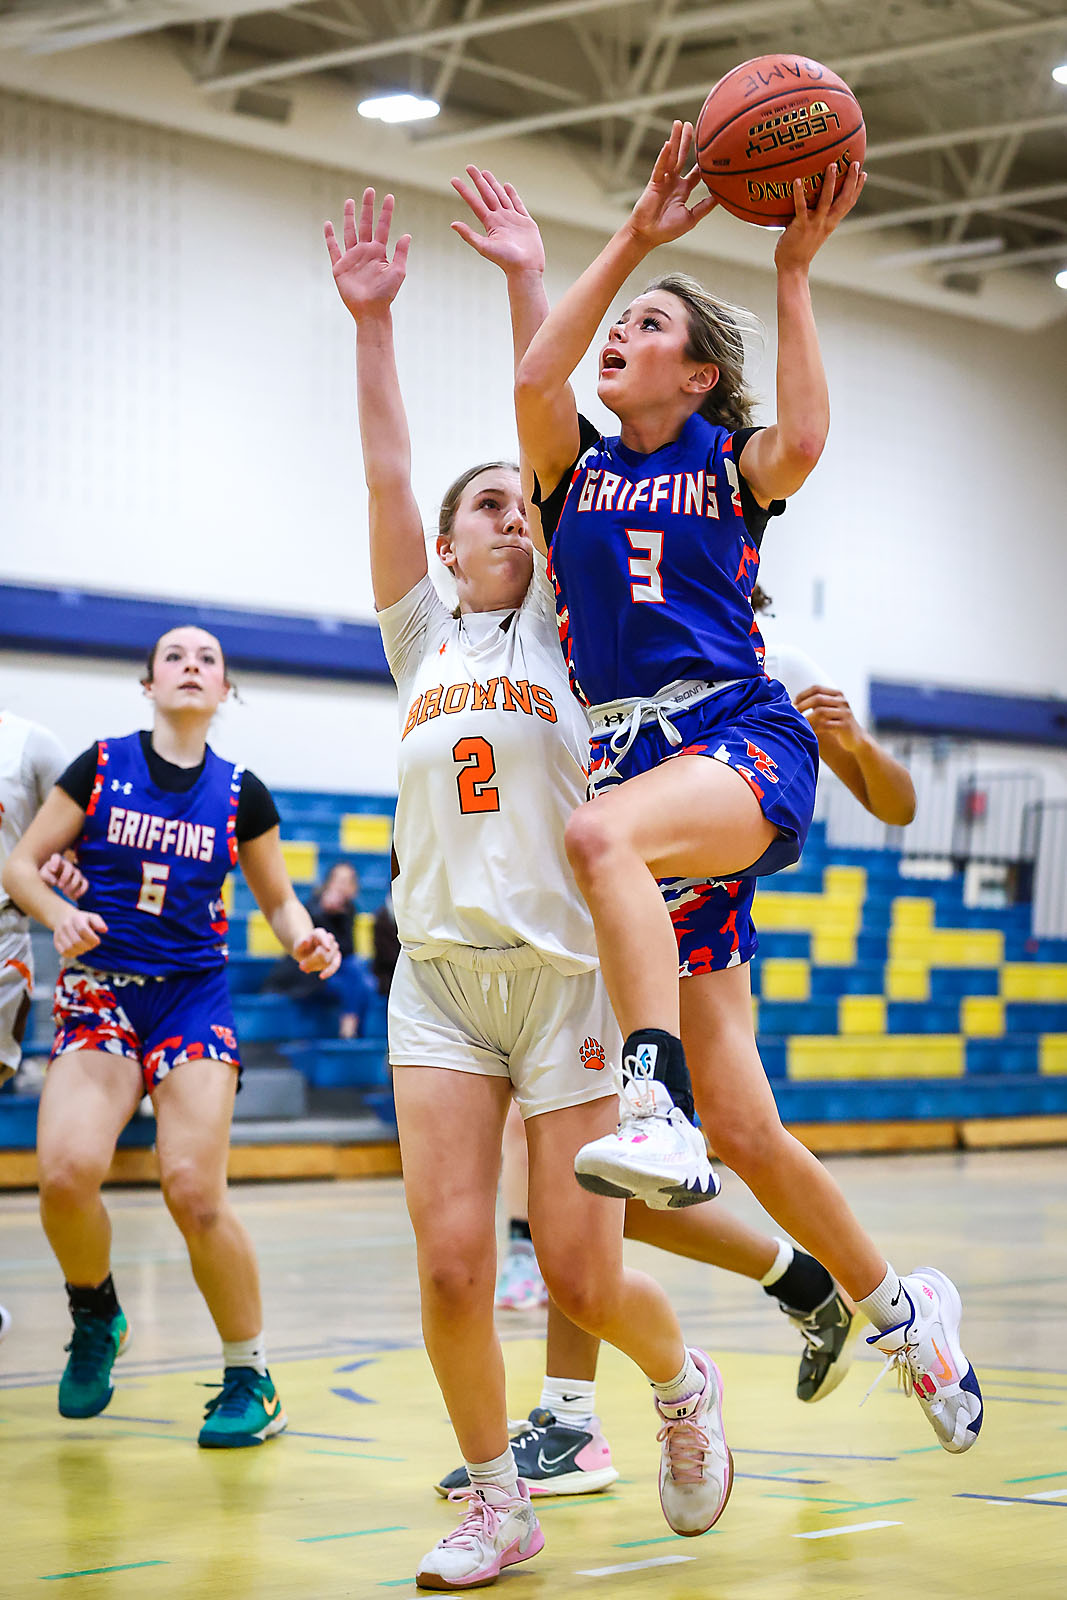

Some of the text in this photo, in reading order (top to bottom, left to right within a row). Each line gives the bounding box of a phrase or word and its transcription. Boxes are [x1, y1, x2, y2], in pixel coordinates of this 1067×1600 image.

[741, 62, 824, 98] GAME
[745, 112, 841, 159] LEGACY
[577, 468, 720, 520] GRIFFINS
[625, 528, 666, 604] 3
[401, 676, 558, 742] BROWNS
[452, 736, 501, 815] 2
[107, 806, 216, 863] GRIFFINS
[136, 861, 170, 917] 6
